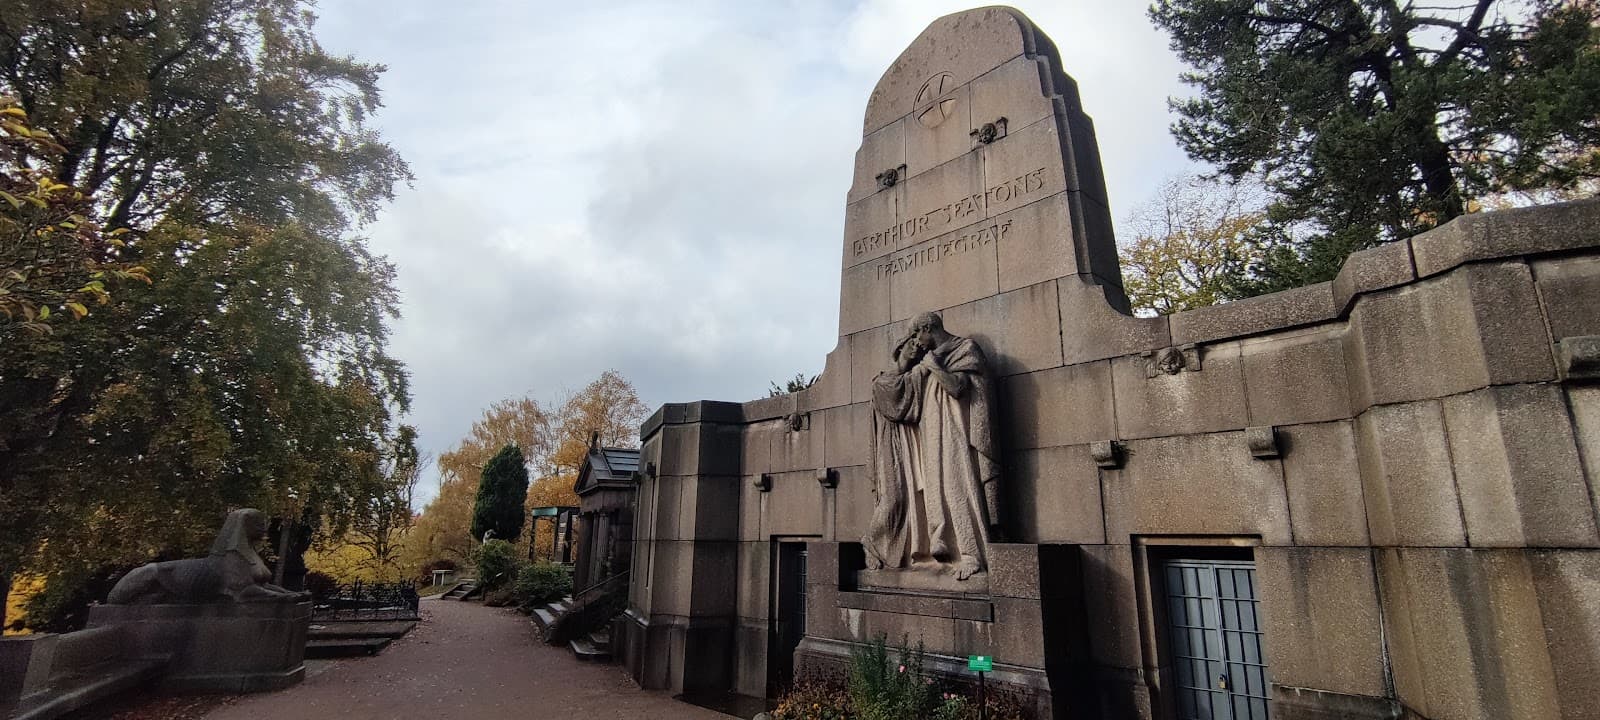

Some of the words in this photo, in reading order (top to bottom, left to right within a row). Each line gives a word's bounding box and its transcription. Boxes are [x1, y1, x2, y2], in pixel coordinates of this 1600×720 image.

[854, 216, 930, 256] ARTHUR
[942, 168, 1045, 223] SEATONS
[879, 220, 1012, 279] FAMILIEGRAF
